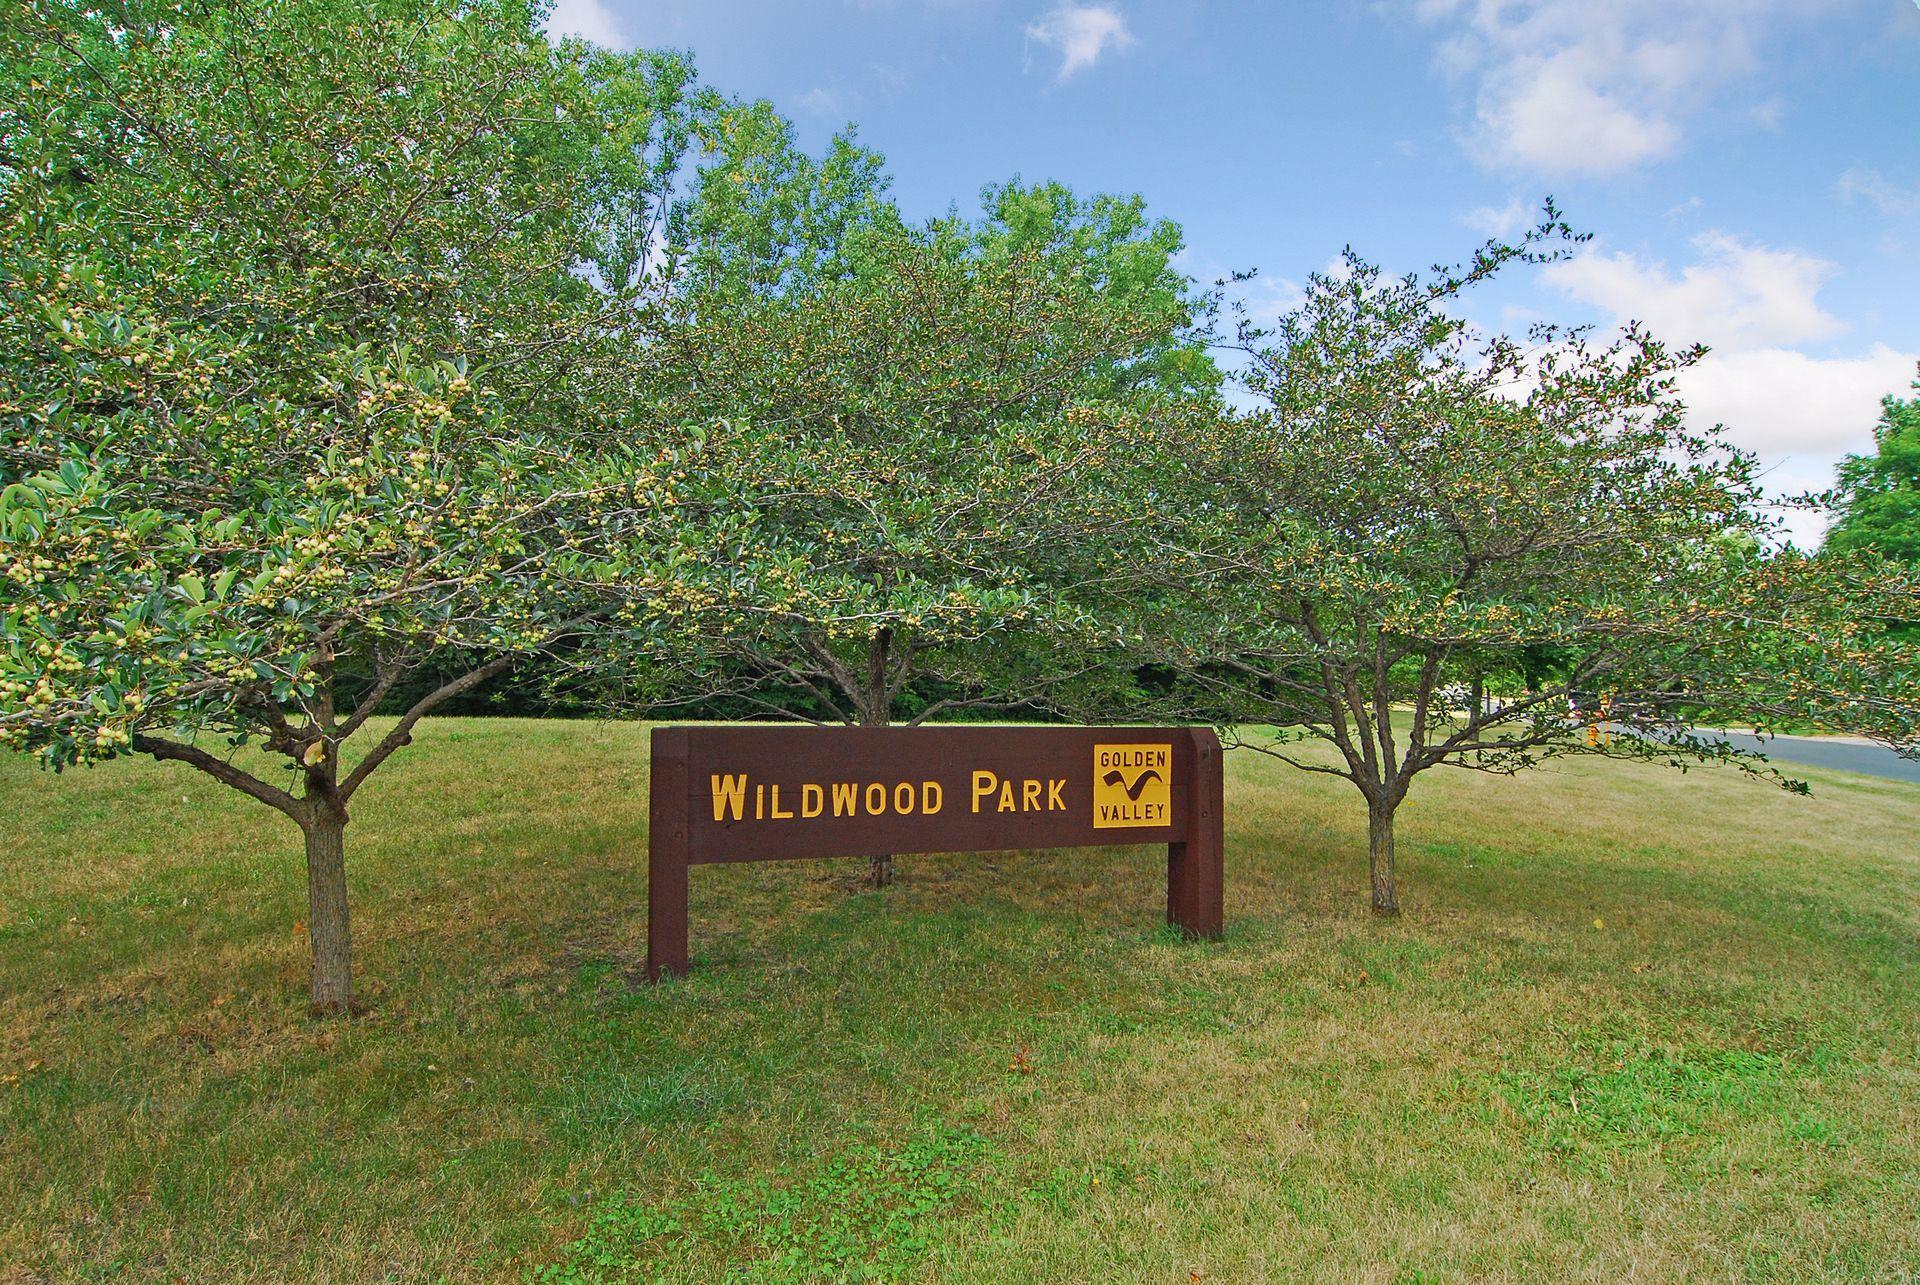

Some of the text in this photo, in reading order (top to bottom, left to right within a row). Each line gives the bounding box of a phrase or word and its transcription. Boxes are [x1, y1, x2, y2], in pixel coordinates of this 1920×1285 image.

[1100, 751, 1166, 767] GOLDEN
[711, 770, 1067, 821] WILDWOOD PARK
[1100, 804, 1165, 821] VALLEY
